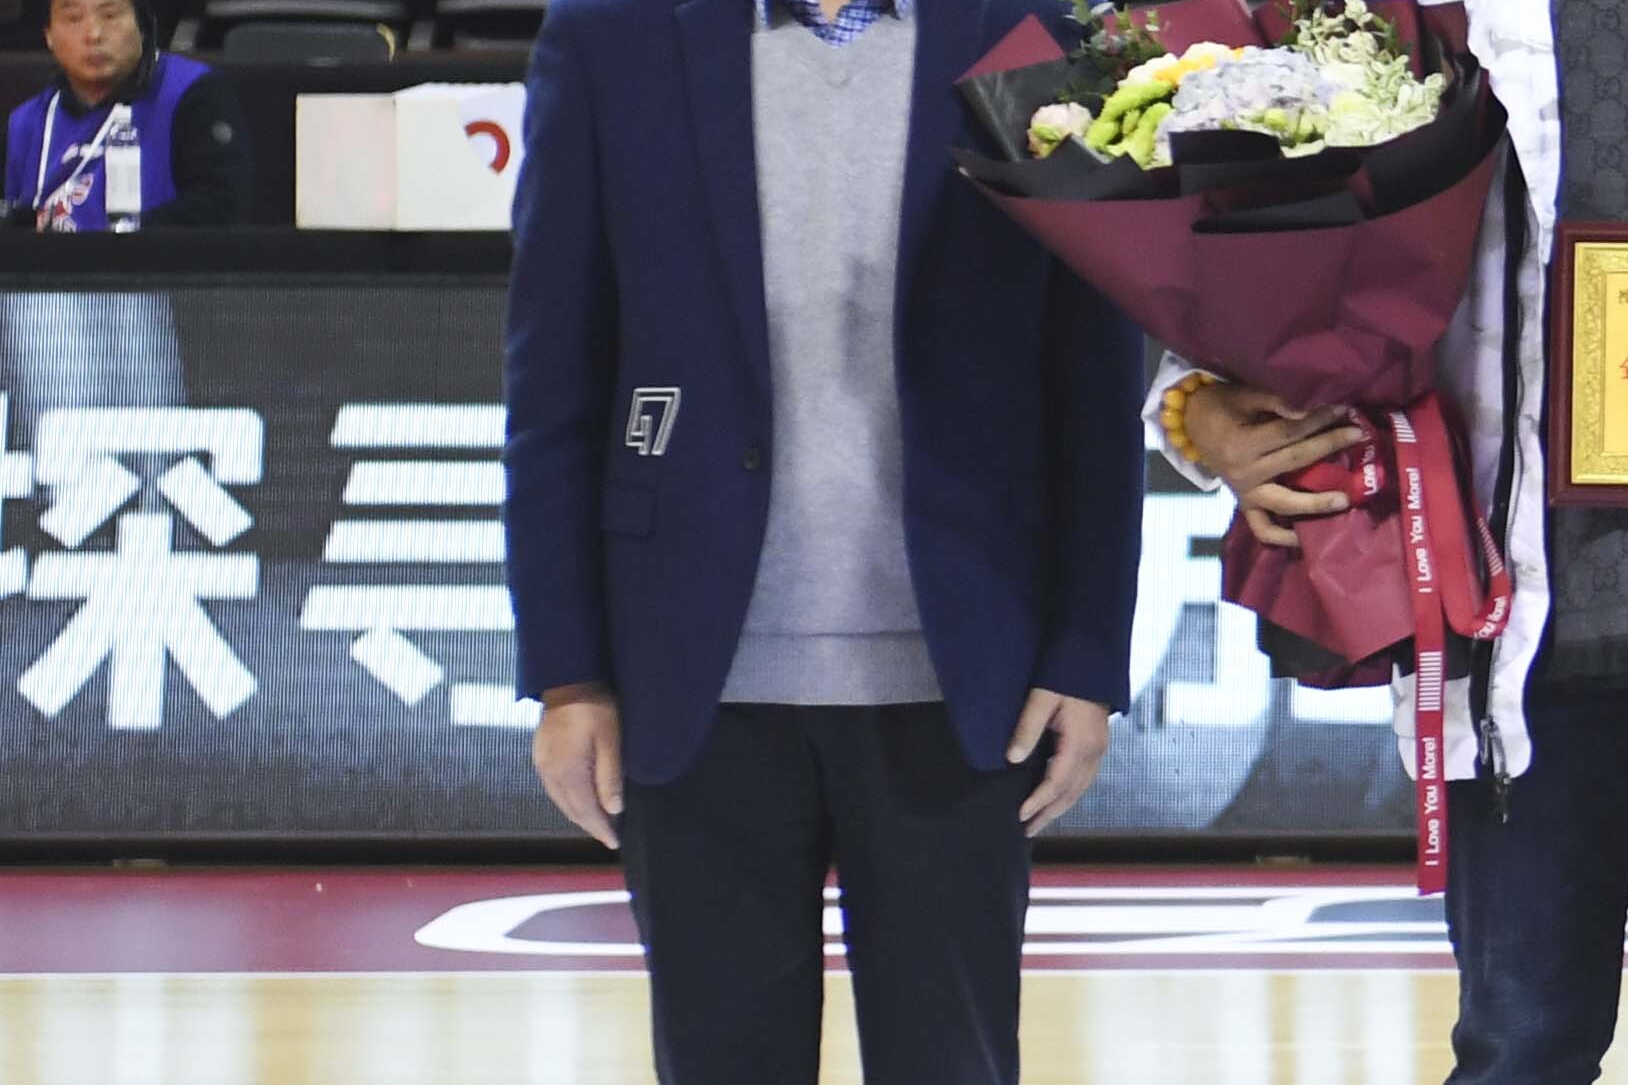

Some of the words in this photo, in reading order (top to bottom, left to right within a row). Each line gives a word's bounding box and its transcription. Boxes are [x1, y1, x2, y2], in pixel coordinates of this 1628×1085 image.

[1409, 514, 1424, 543] You
[1415, 547, 1432, 582] Love
[1423, 784, 1439, 814] You
[1424, 817, 1440, 854] Love
